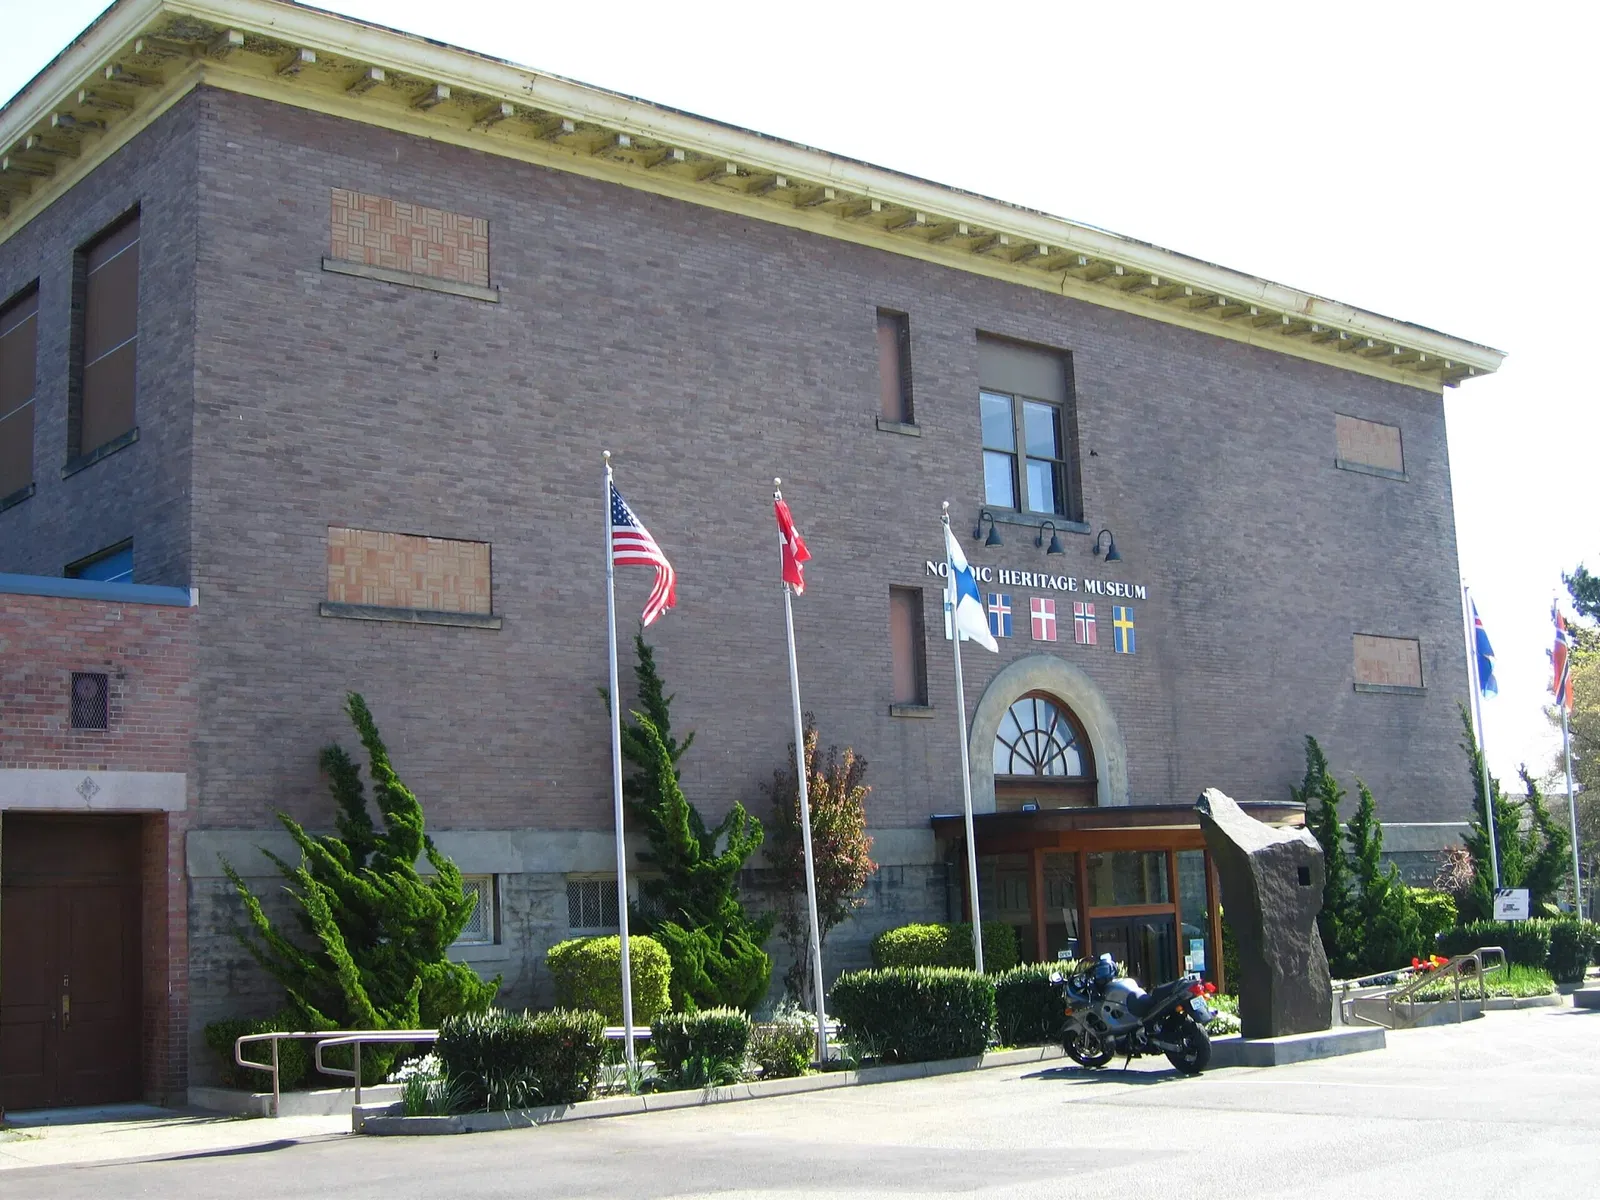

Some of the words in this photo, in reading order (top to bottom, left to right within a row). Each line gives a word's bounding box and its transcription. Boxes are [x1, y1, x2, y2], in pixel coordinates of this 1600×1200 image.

[926, 560, 993, 583] NOIC
[998, 569, 1078, 592] HERITAGE
[1083, 578, 1147, 600] MUSEUM
